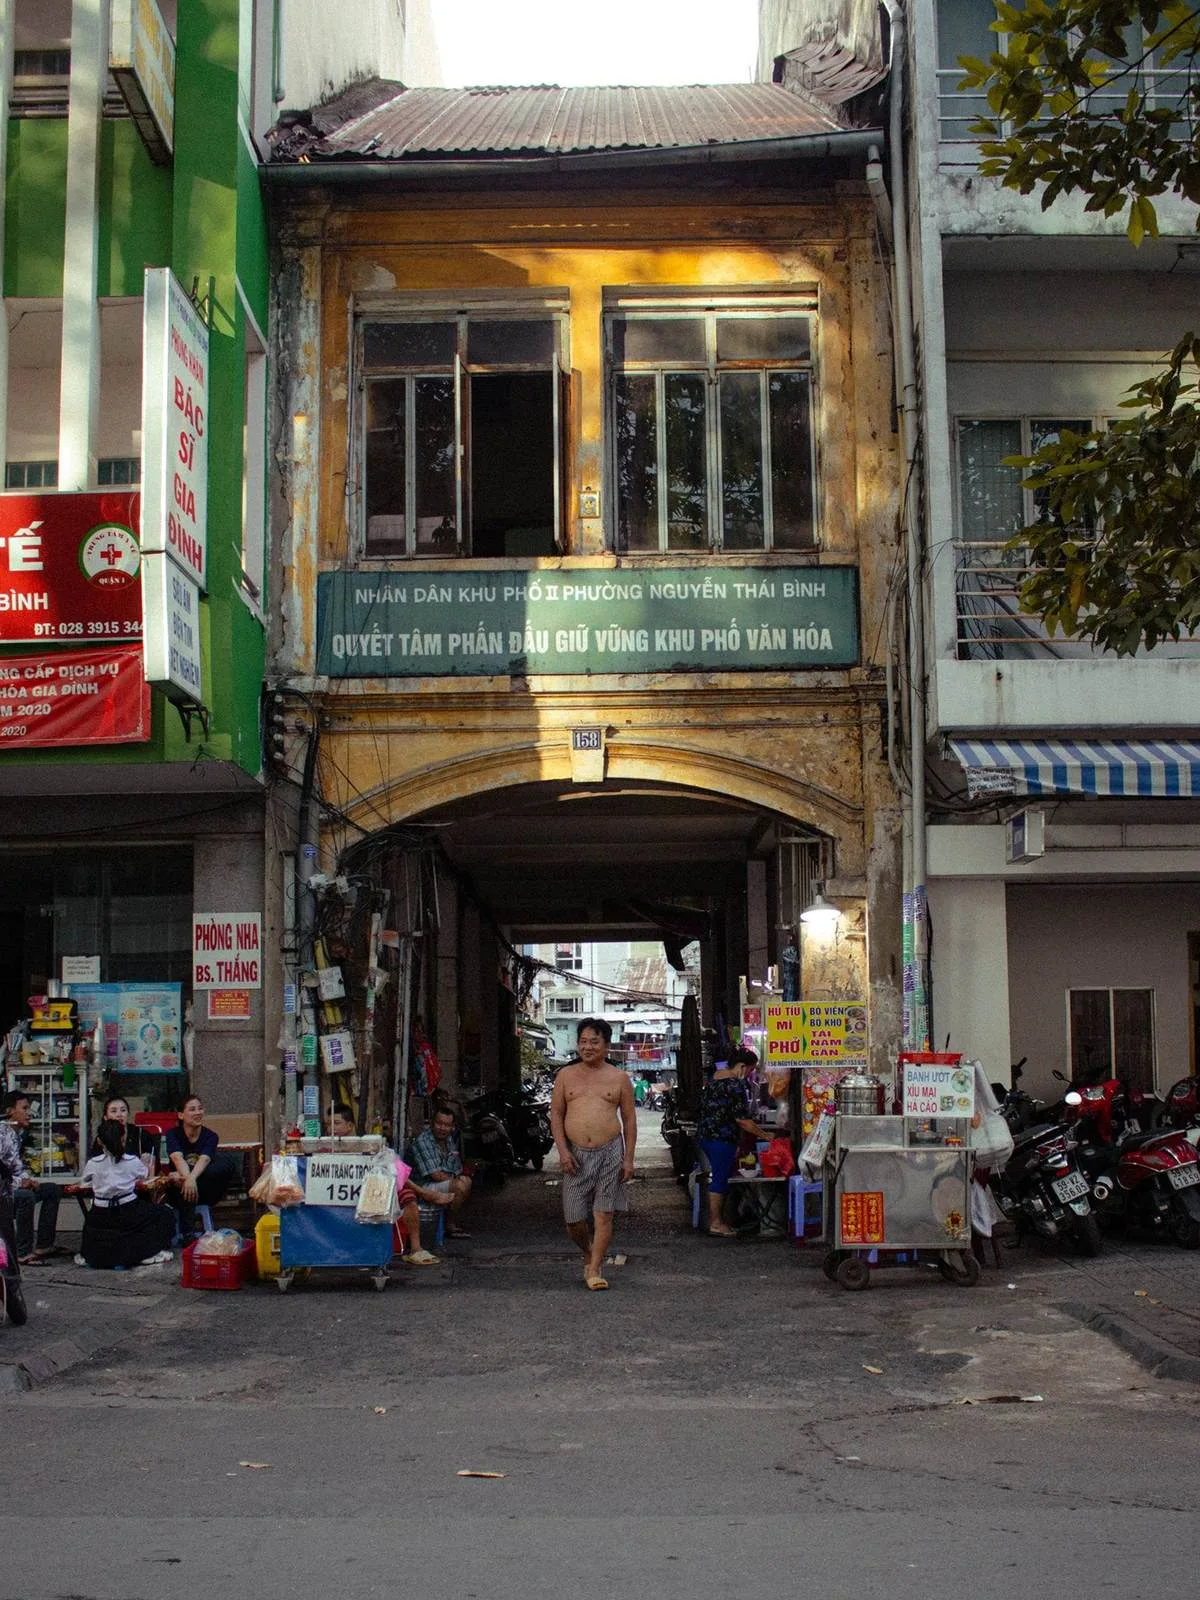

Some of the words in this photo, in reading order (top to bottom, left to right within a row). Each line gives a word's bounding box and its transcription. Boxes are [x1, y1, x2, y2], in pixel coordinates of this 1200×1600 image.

[174, 376, 203, 437] BÁC
[174, 472, 196, 523] GIA
[168, 511, 203, 574] ĐÌNH
[355, 584, 407, 604] NHÂN
[414, 583, 452, 604] DÂN
[458, 586, 497, 603] KHU
[503, 578, 542, 602] PHỐ
[545, 584, 559, 601] II
[562, 580, 643, 601] PHƯỜNG
[650, 576, 727, 600] NGUYỄN
[733, 580, 776, 599] THÁI
[783, 579, 826, 598] BÌNH
[34, 622, 56, 636] ĐT:
[58, 622, 84, 635] 028
[87, 621, 120, 634] 3915
[332, 622, 393, 658] QUYẾT
[399, 628, 442, 656] TÂM
[448, 620, 503, 656] PHẤN
[508, 619, 549, 654] ĐẤU
[555, 624, 590, 653] GIỮ
[595, 624, 649, 652] VỮNG
[654, 628, 695, 652] KHU
[701, 618, 742, 651] PHỐ
[746, 623, 788, 651] VĂN
[792, 622, 833, 650] HÓA
[24, 663, 54, 680] CẤP
[59, 665, 95, 680] DỊCH
[99, 663, 119, 678] VỤ
[32, 686, 57, 697] GIA
[61, 681, 98, 696] ĐÌNH
[16, 704, 51, 716] 2020
[575, 732, 598, 748] 158
[195, 918, 232, 951] PHÒNG
[236, 923, 259, 950] NHA
[196, 965, 214, 983] BS.
[216, 952, 258, 982] THẮNG
[824, 1018, 842, 1027] KHO
[769, 1036, 801, 1054] PHỞ
[326, 1184, 362, 1201] 15K
